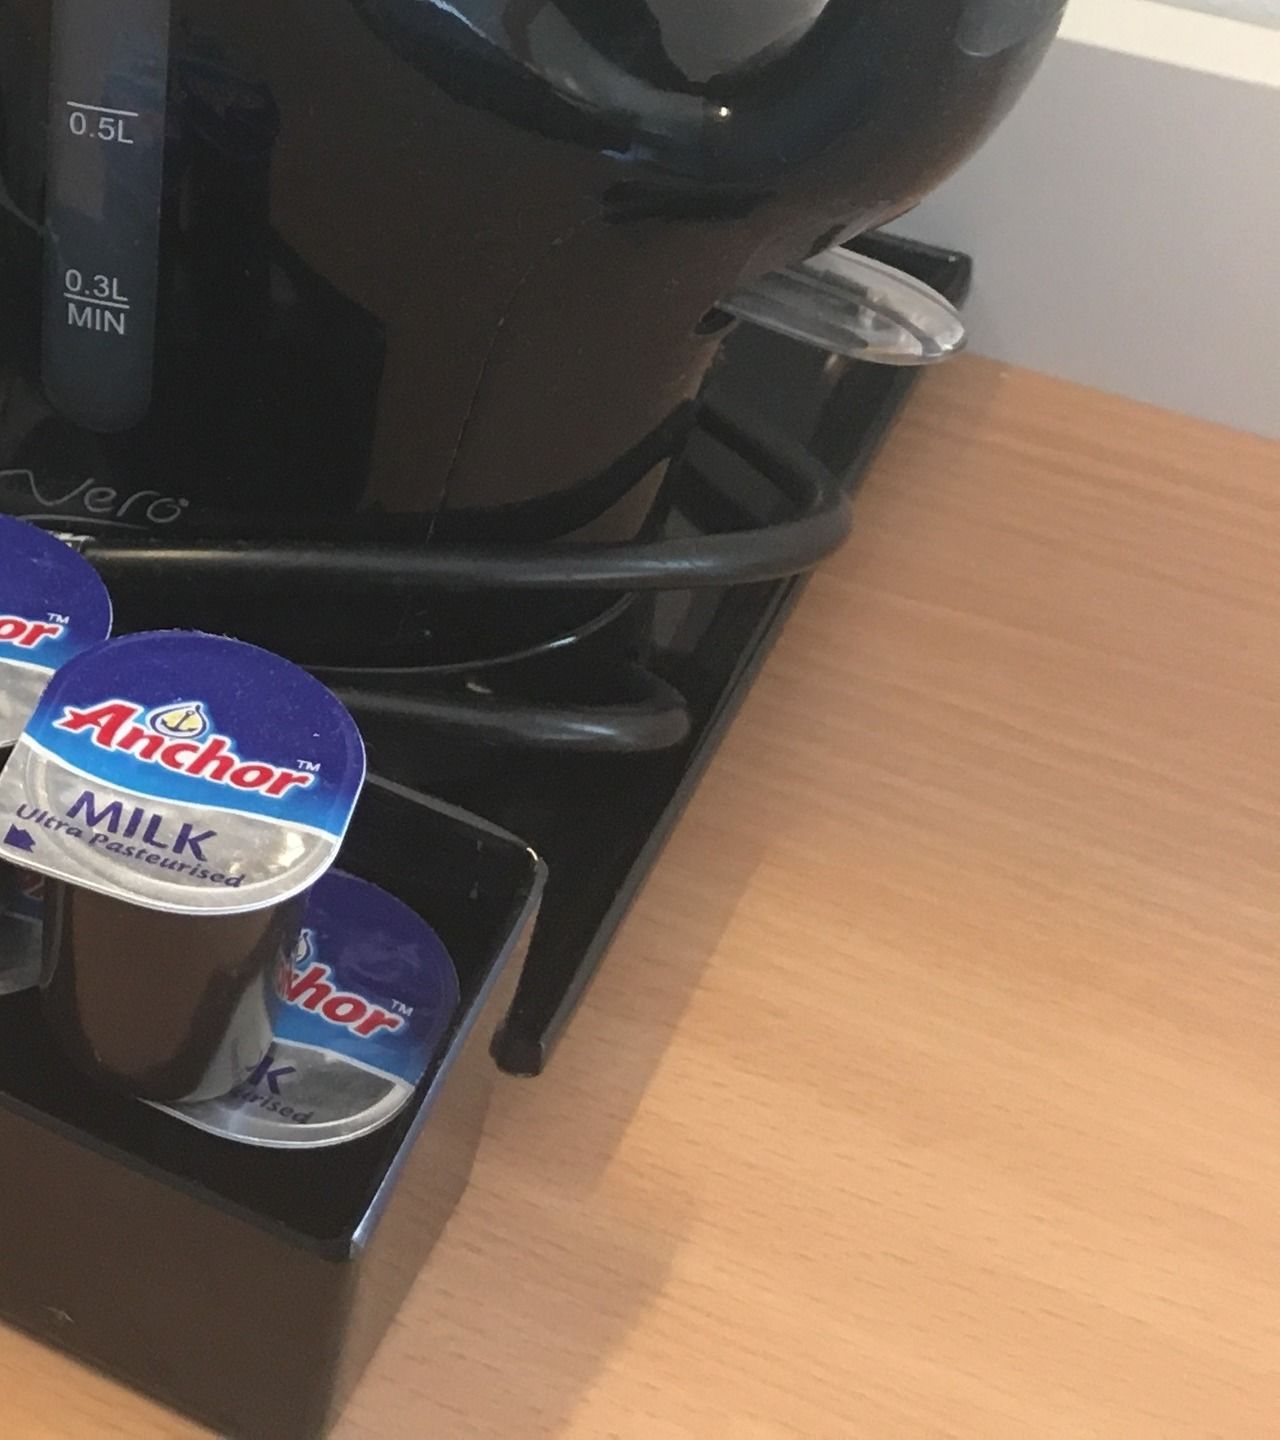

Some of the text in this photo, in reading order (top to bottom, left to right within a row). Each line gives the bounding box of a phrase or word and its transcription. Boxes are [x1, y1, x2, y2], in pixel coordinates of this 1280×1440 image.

[68, 111, 134, 145] 0.5L
[64, 268, 129, 302] 0.3L
[67, 302, 126, 336] MIN
[57, 702, 311, 797] Anchor
[15, 803, 247, 888] Ultra Pasteurised
[65, 790, 218, 862] MILK
